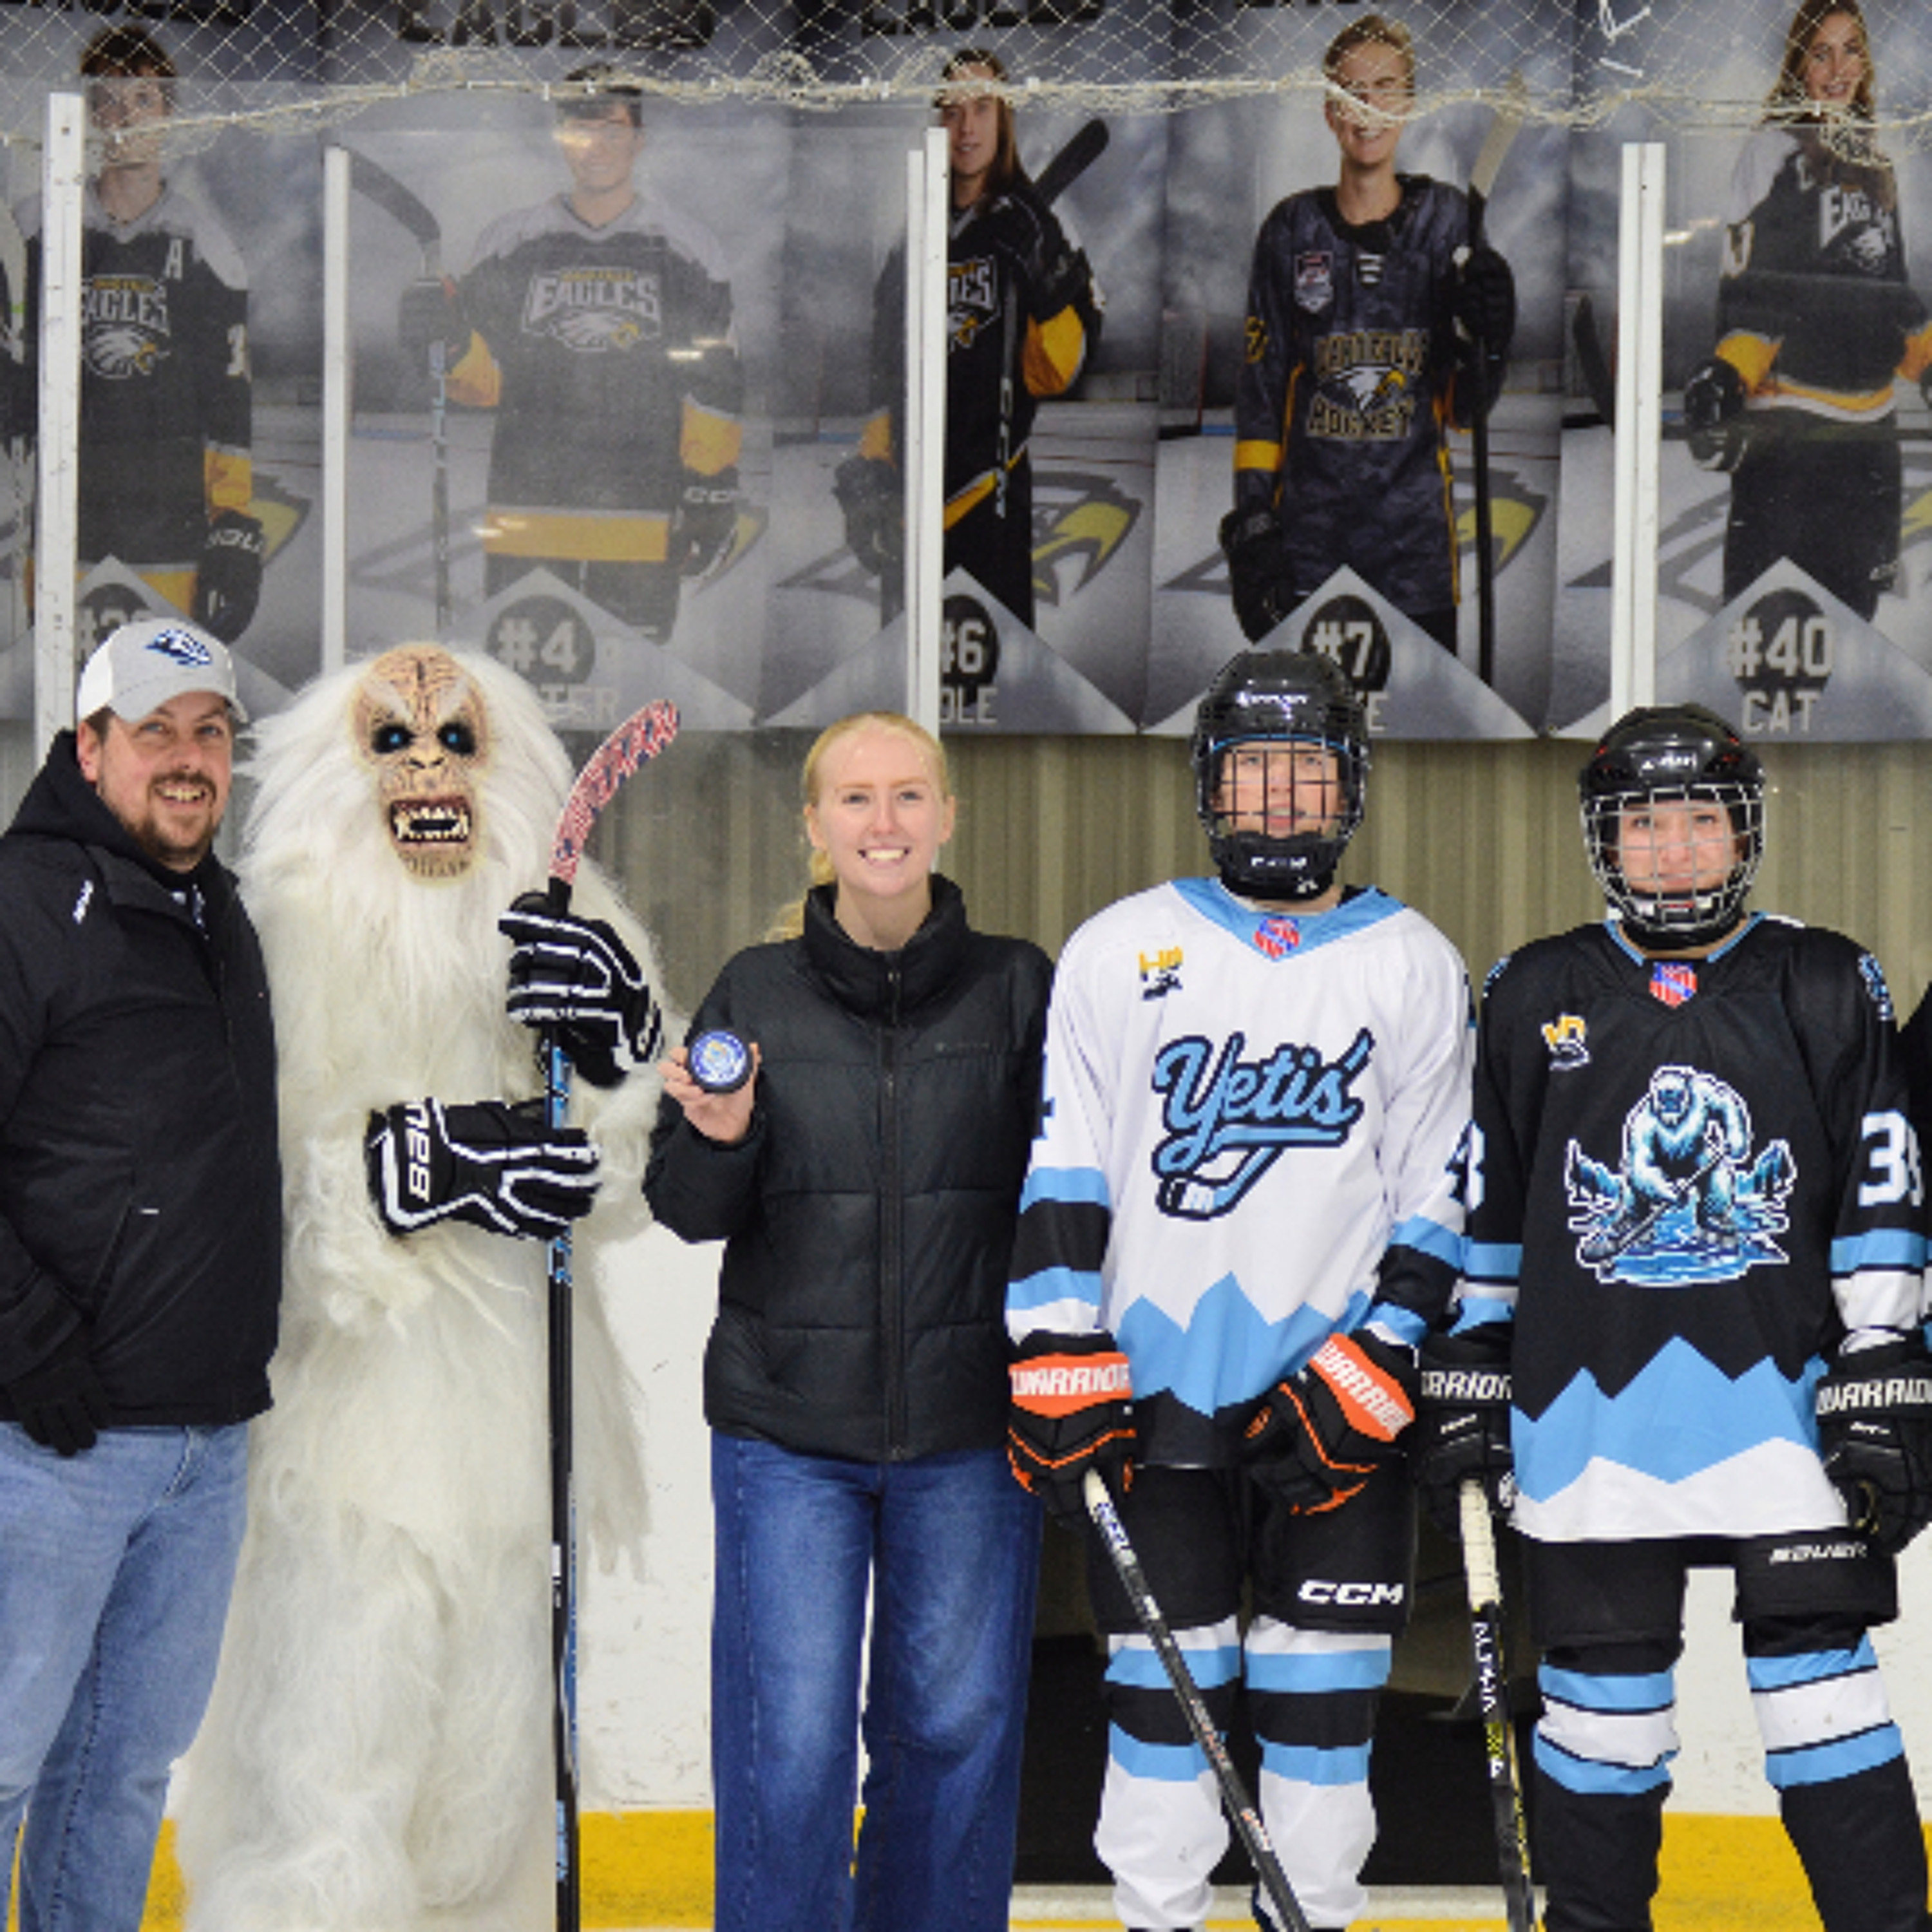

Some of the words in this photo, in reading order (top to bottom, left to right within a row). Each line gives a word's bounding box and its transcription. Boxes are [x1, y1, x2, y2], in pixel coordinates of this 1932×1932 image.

[529, 272, 660, 322] EAGLES
[497, 618, 578, 675] #4
[1312, 621, 1374, 678] #7
[1727, 615, 1834, 677] #40
[1742, 689, 1821, 735] CAT
[1298, 1580, 1404, 1605] CCM
